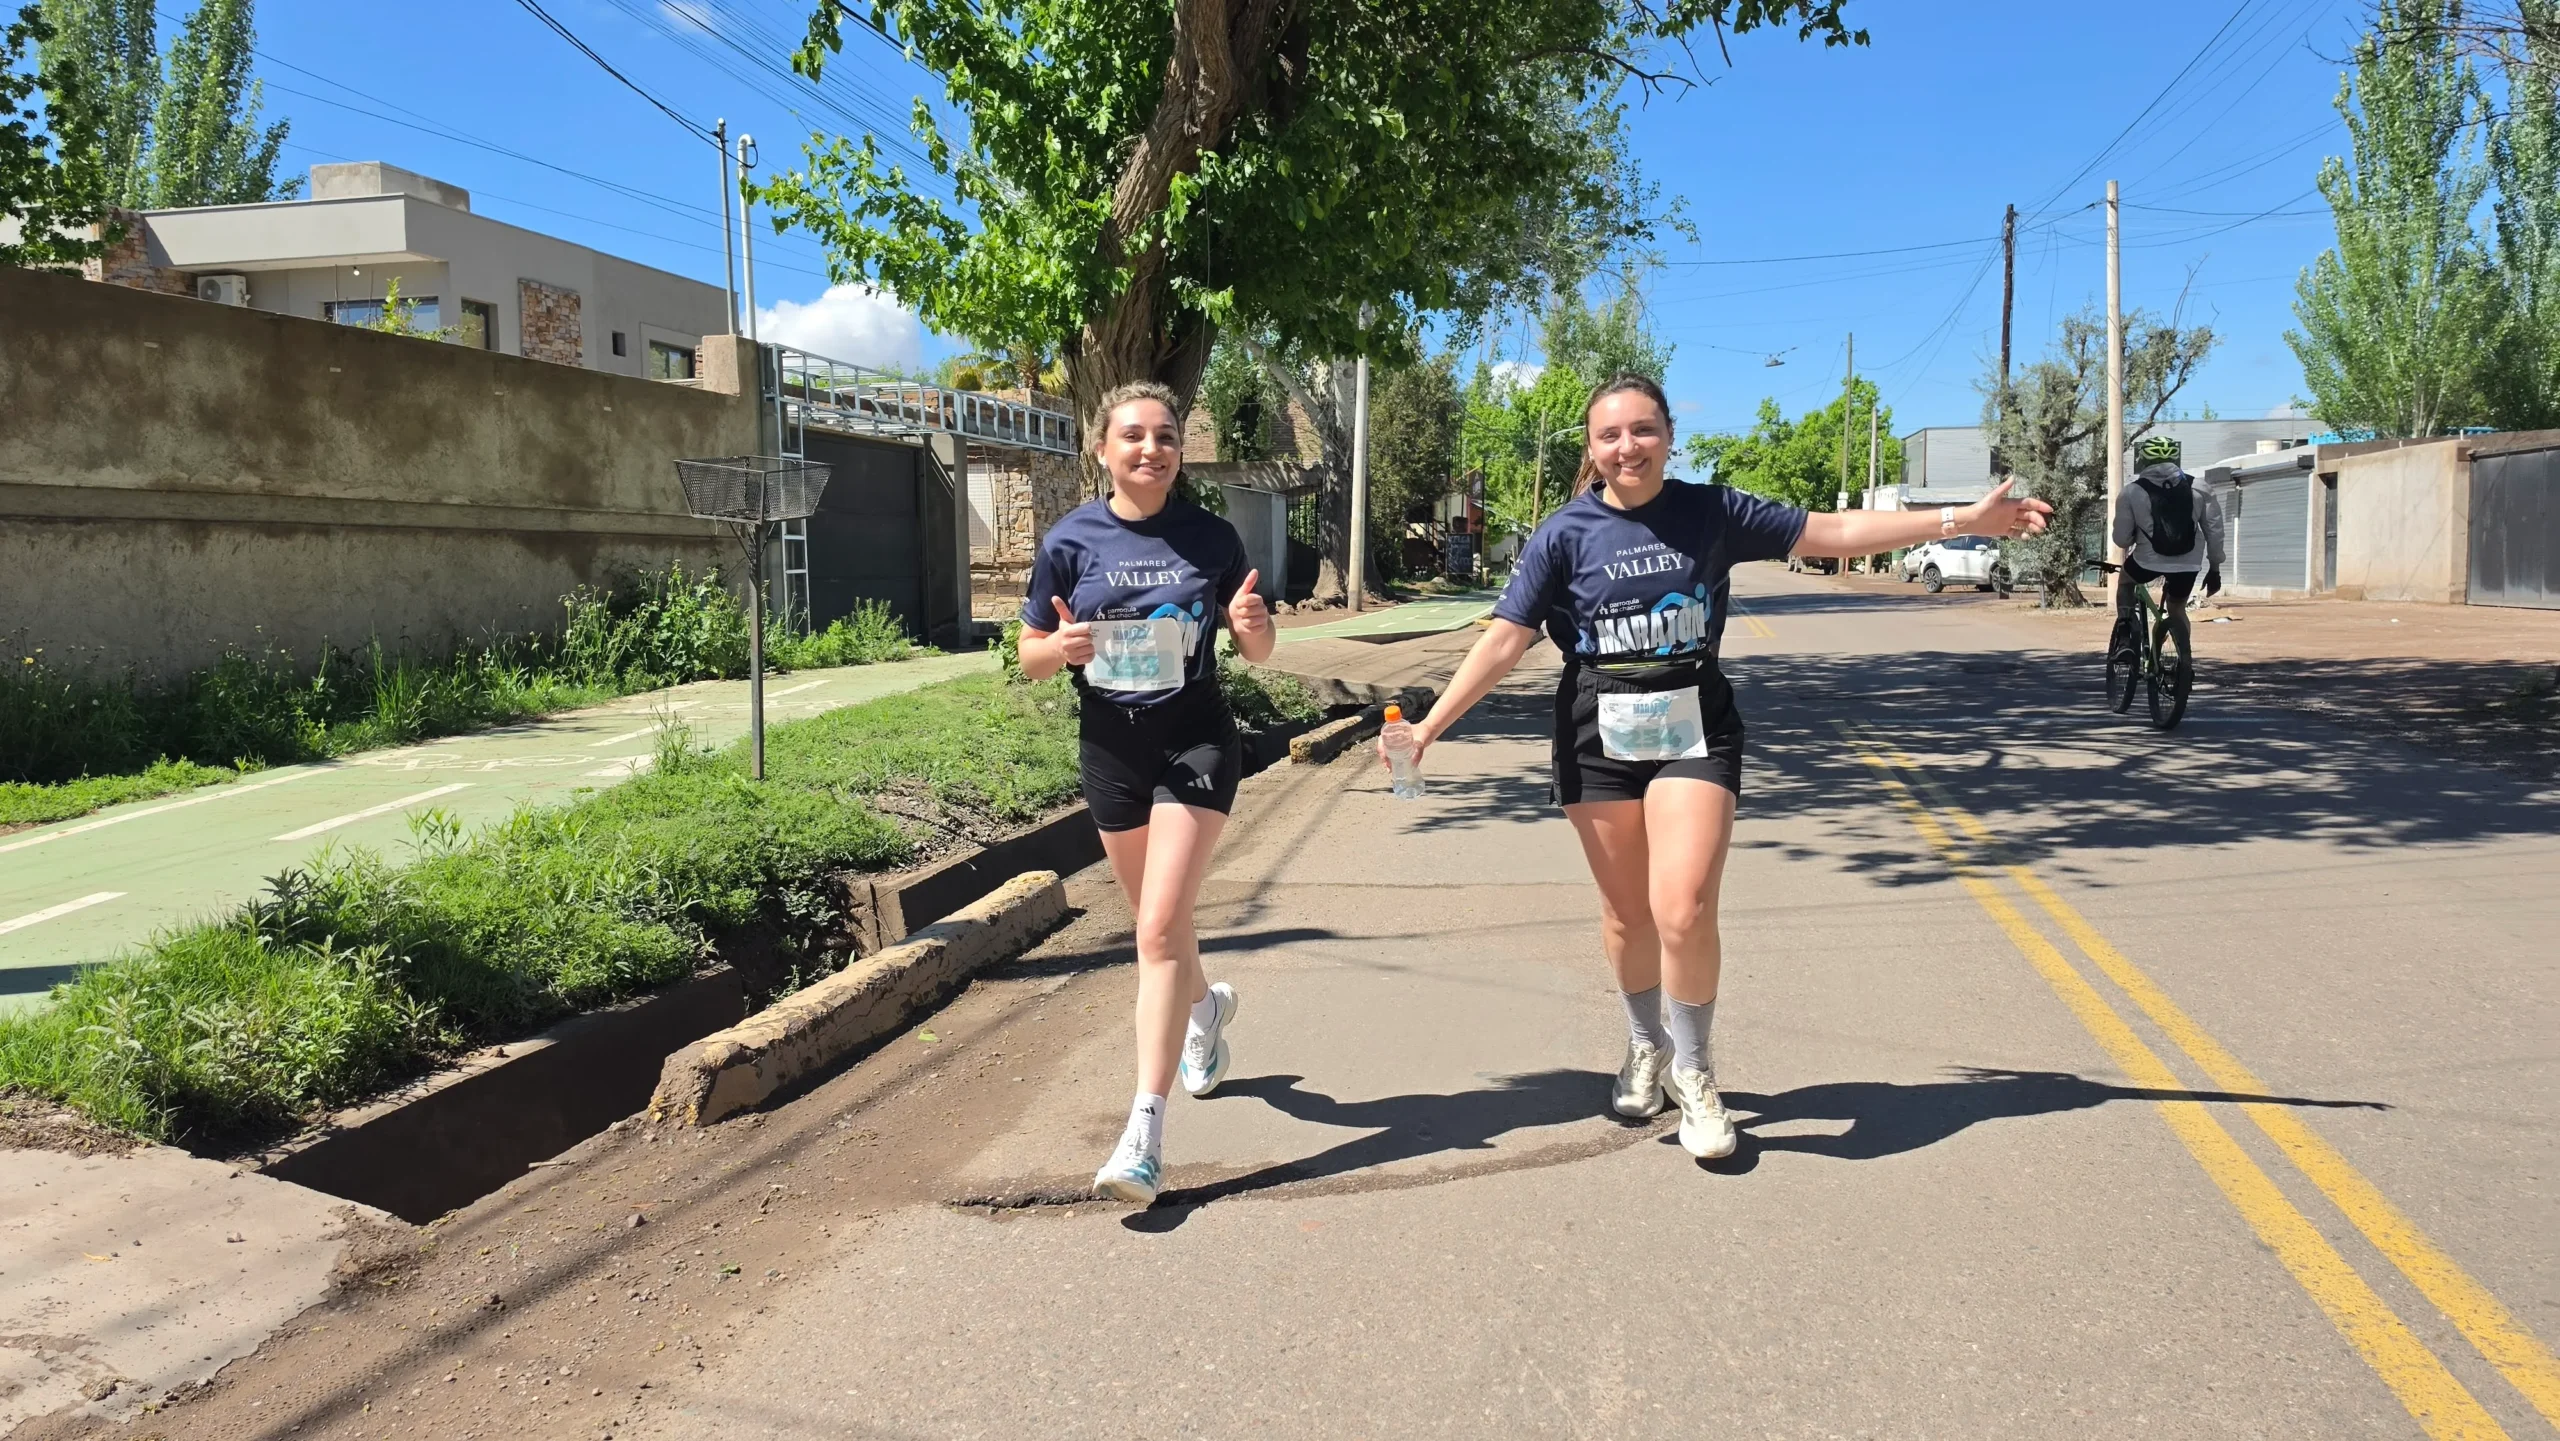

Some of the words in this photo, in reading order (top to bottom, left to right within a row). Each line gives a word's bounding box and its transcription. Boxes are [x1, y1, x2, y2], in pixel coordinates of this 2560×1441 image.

[1616, 543, 1667, 557] PALMARES
[1603, 552, 1684, 581] VALLEY
[1105, 570, 1184, 587] VALLEY
[1609, 598, 1640, 608] parroquia
[1619, 603, 1643, 612] chacras
[1594, 600, 1706, 655] MARATÓN
[1623, 726, 1682, 748] 254
